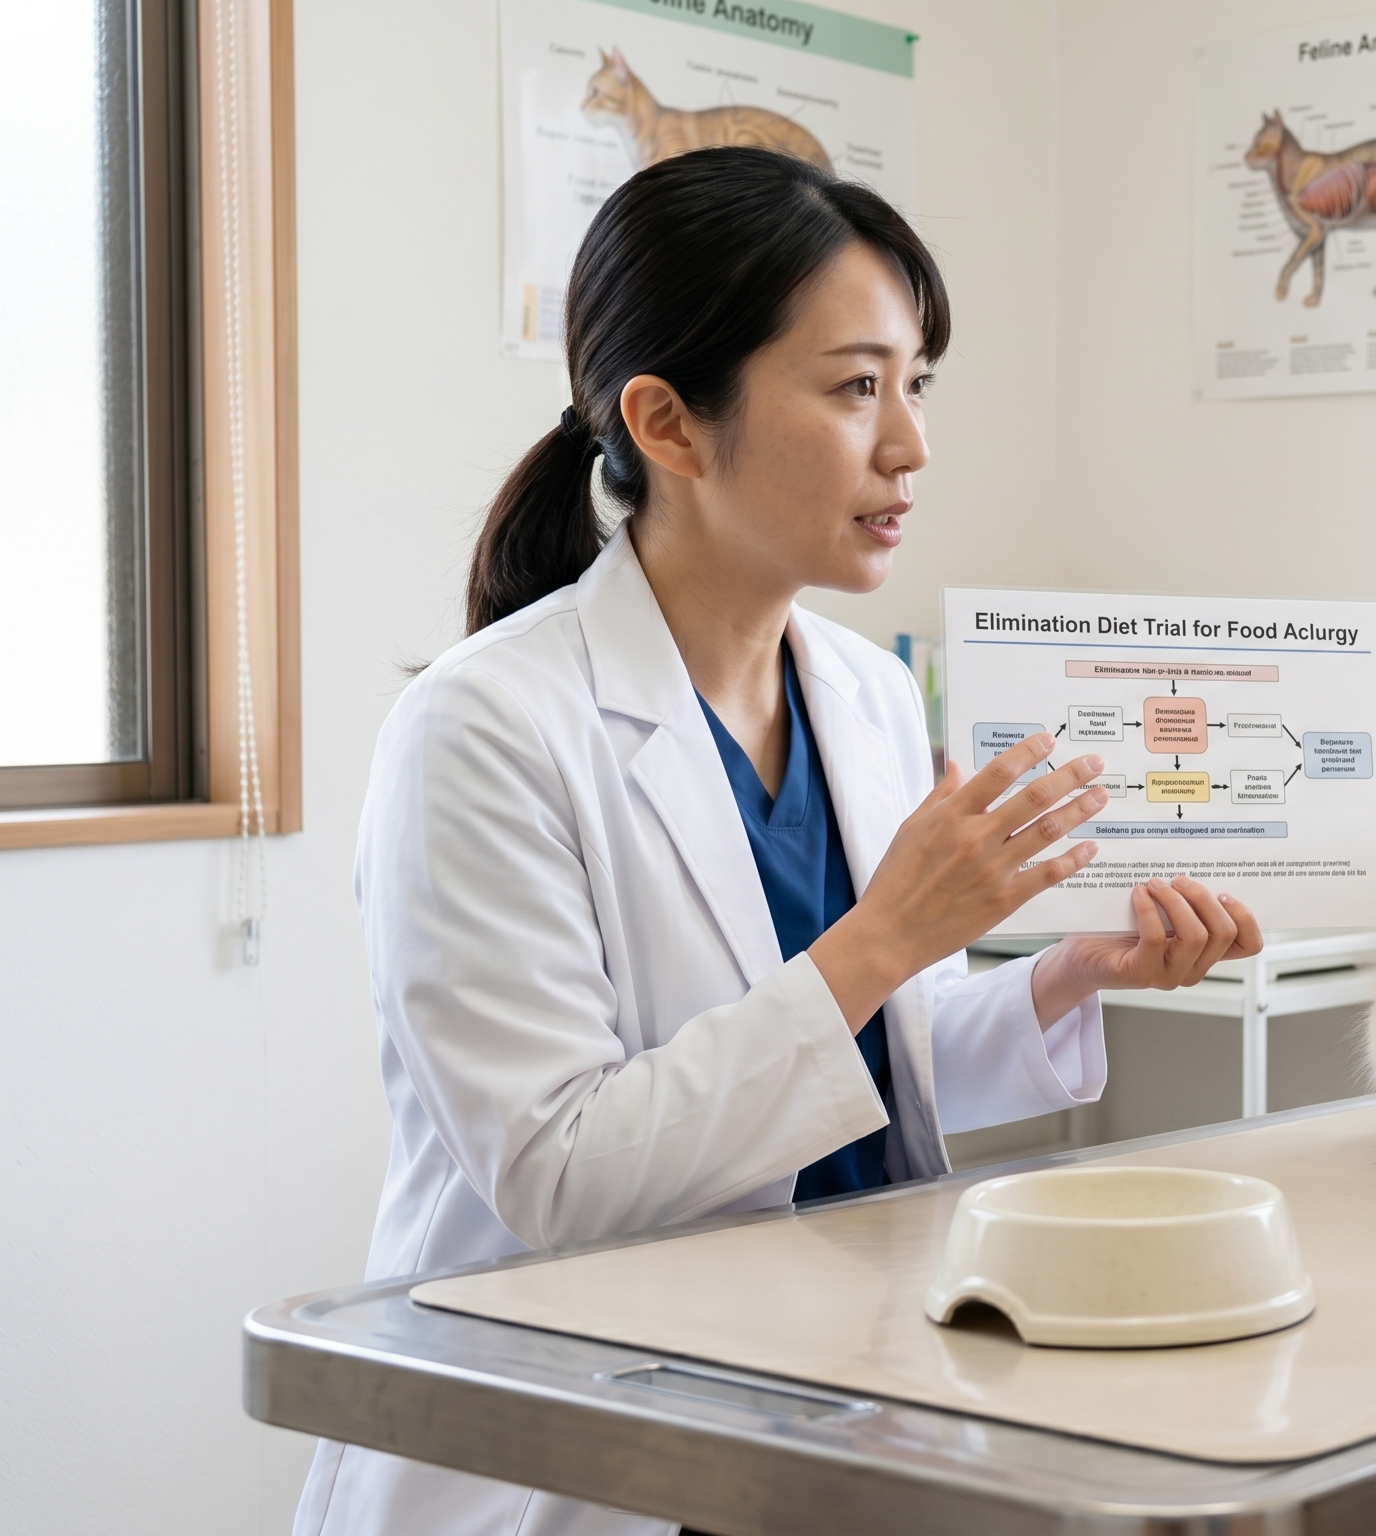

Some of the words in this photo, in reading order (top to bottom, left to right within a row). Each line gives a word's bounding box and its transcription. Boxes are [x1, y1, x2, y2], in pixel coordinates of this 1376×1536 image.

[713, 0, 814, 46] Anatomy
[975, 612, 1091, 634] Elimination
[1097, 616, 1138, 635] Diet
[1143, 617, 1187, 637] Trial
[1192, 619, 1221, 638] for
[1227, 620, 1278, 640] Food
[1283, 622, 1360, 646] Aclurgy
